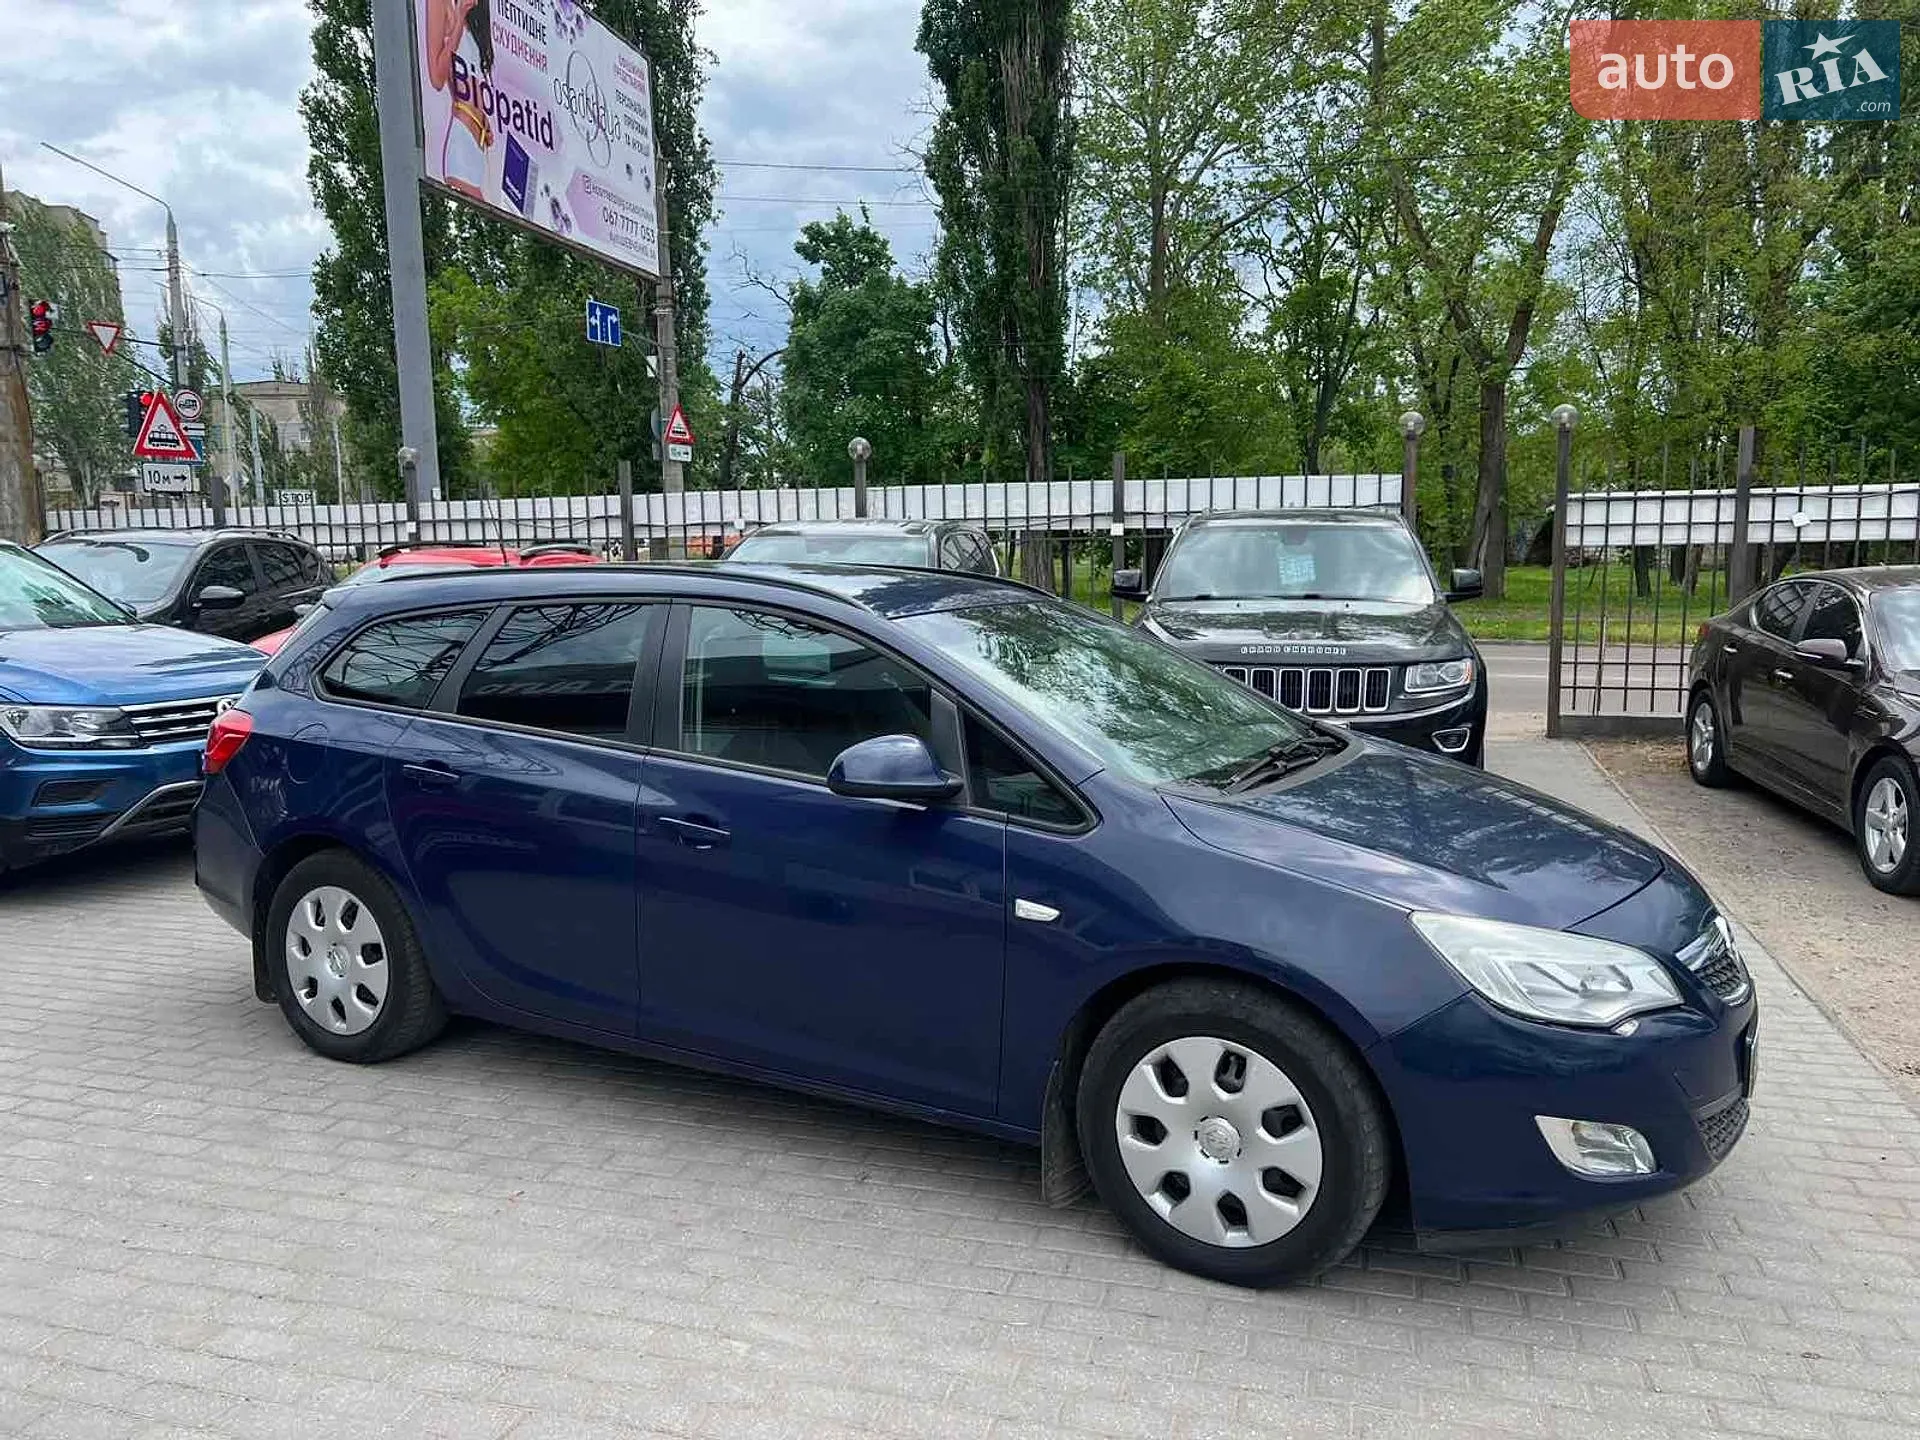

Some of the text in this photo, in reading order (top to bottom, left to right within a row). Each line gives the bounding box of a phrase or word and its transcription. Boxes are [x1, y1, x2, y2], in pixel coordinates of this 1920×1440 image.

[492, 21, 548, 73] СХУДНЕННЯ
[453, 51, 554, 151] Biopatid
[602, 206, 655, 244] 067 7777 053
[282, 492, 312, 503] STOP
